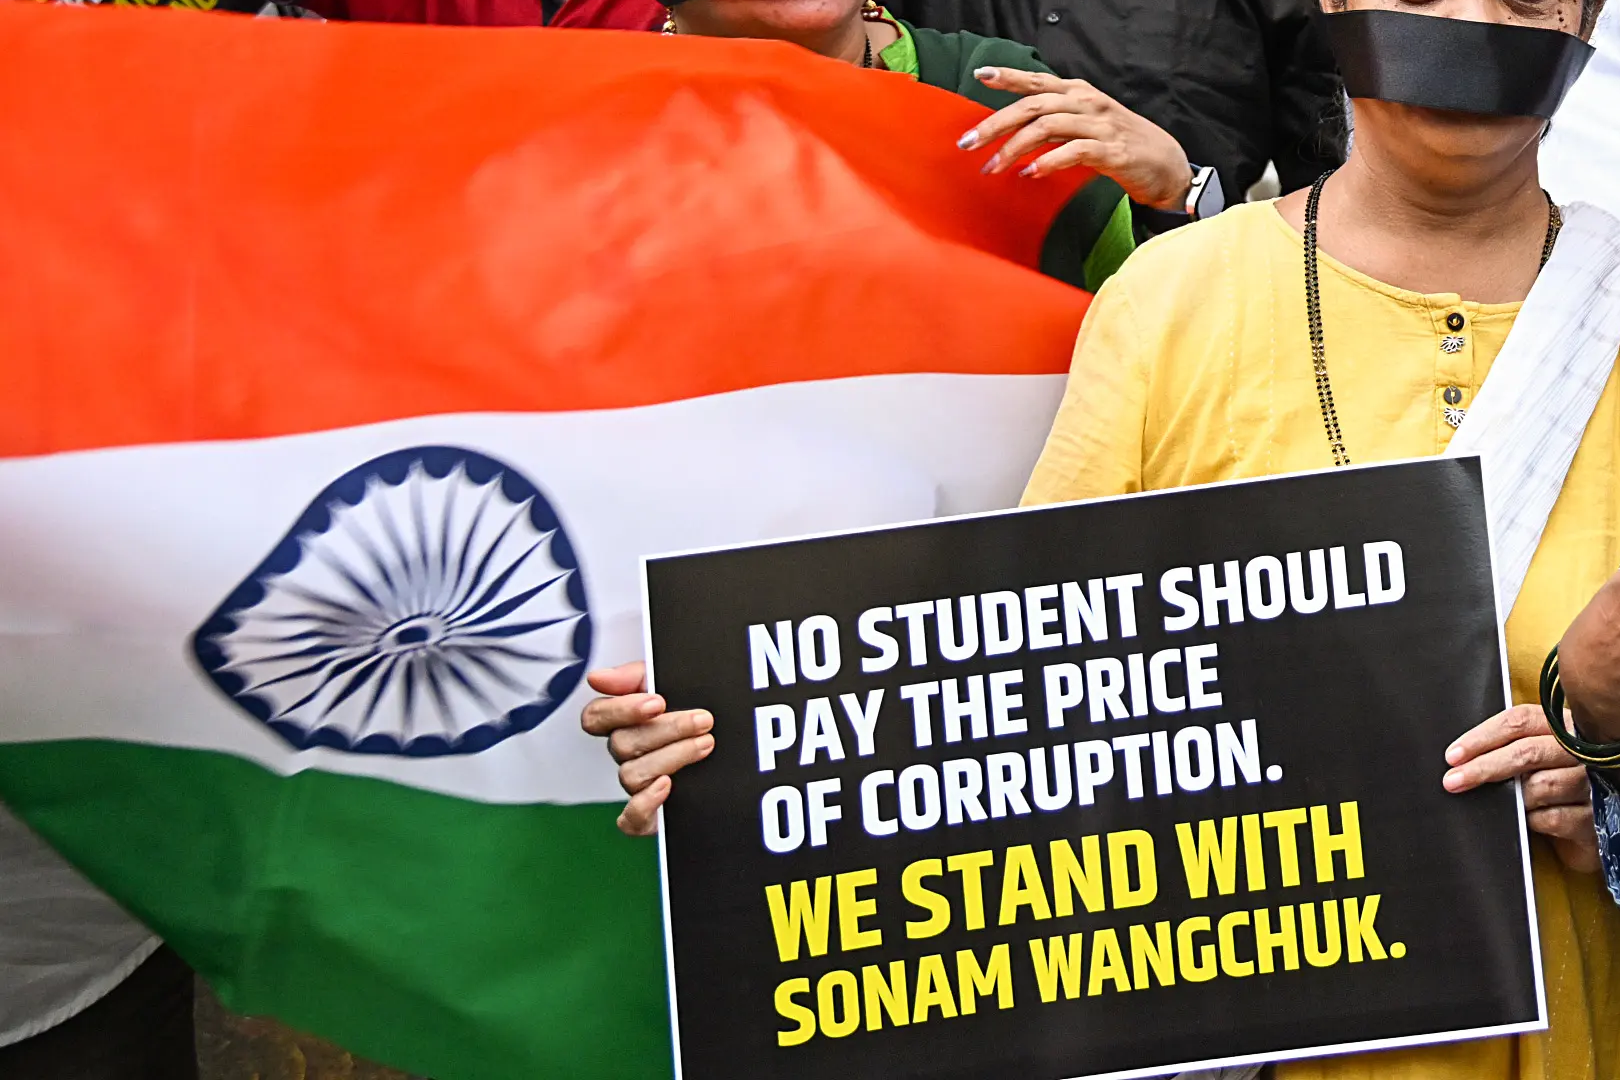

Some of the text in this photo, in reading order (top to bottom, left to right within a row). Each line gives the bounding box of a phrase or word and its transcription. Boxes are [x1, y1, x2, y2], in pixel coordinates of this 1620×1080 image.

[749, 541, 1405, 689] NO STUDENT SHOULD
[755, 643, 1222, 771] PAY THE PRICE
[762, 719, 1282, 852] OF CORRUPTION.
[765, 801, 1364, 962] WE STAND WITH
[774, 895, 1406, 1046] SONAM WANGCHUK.
